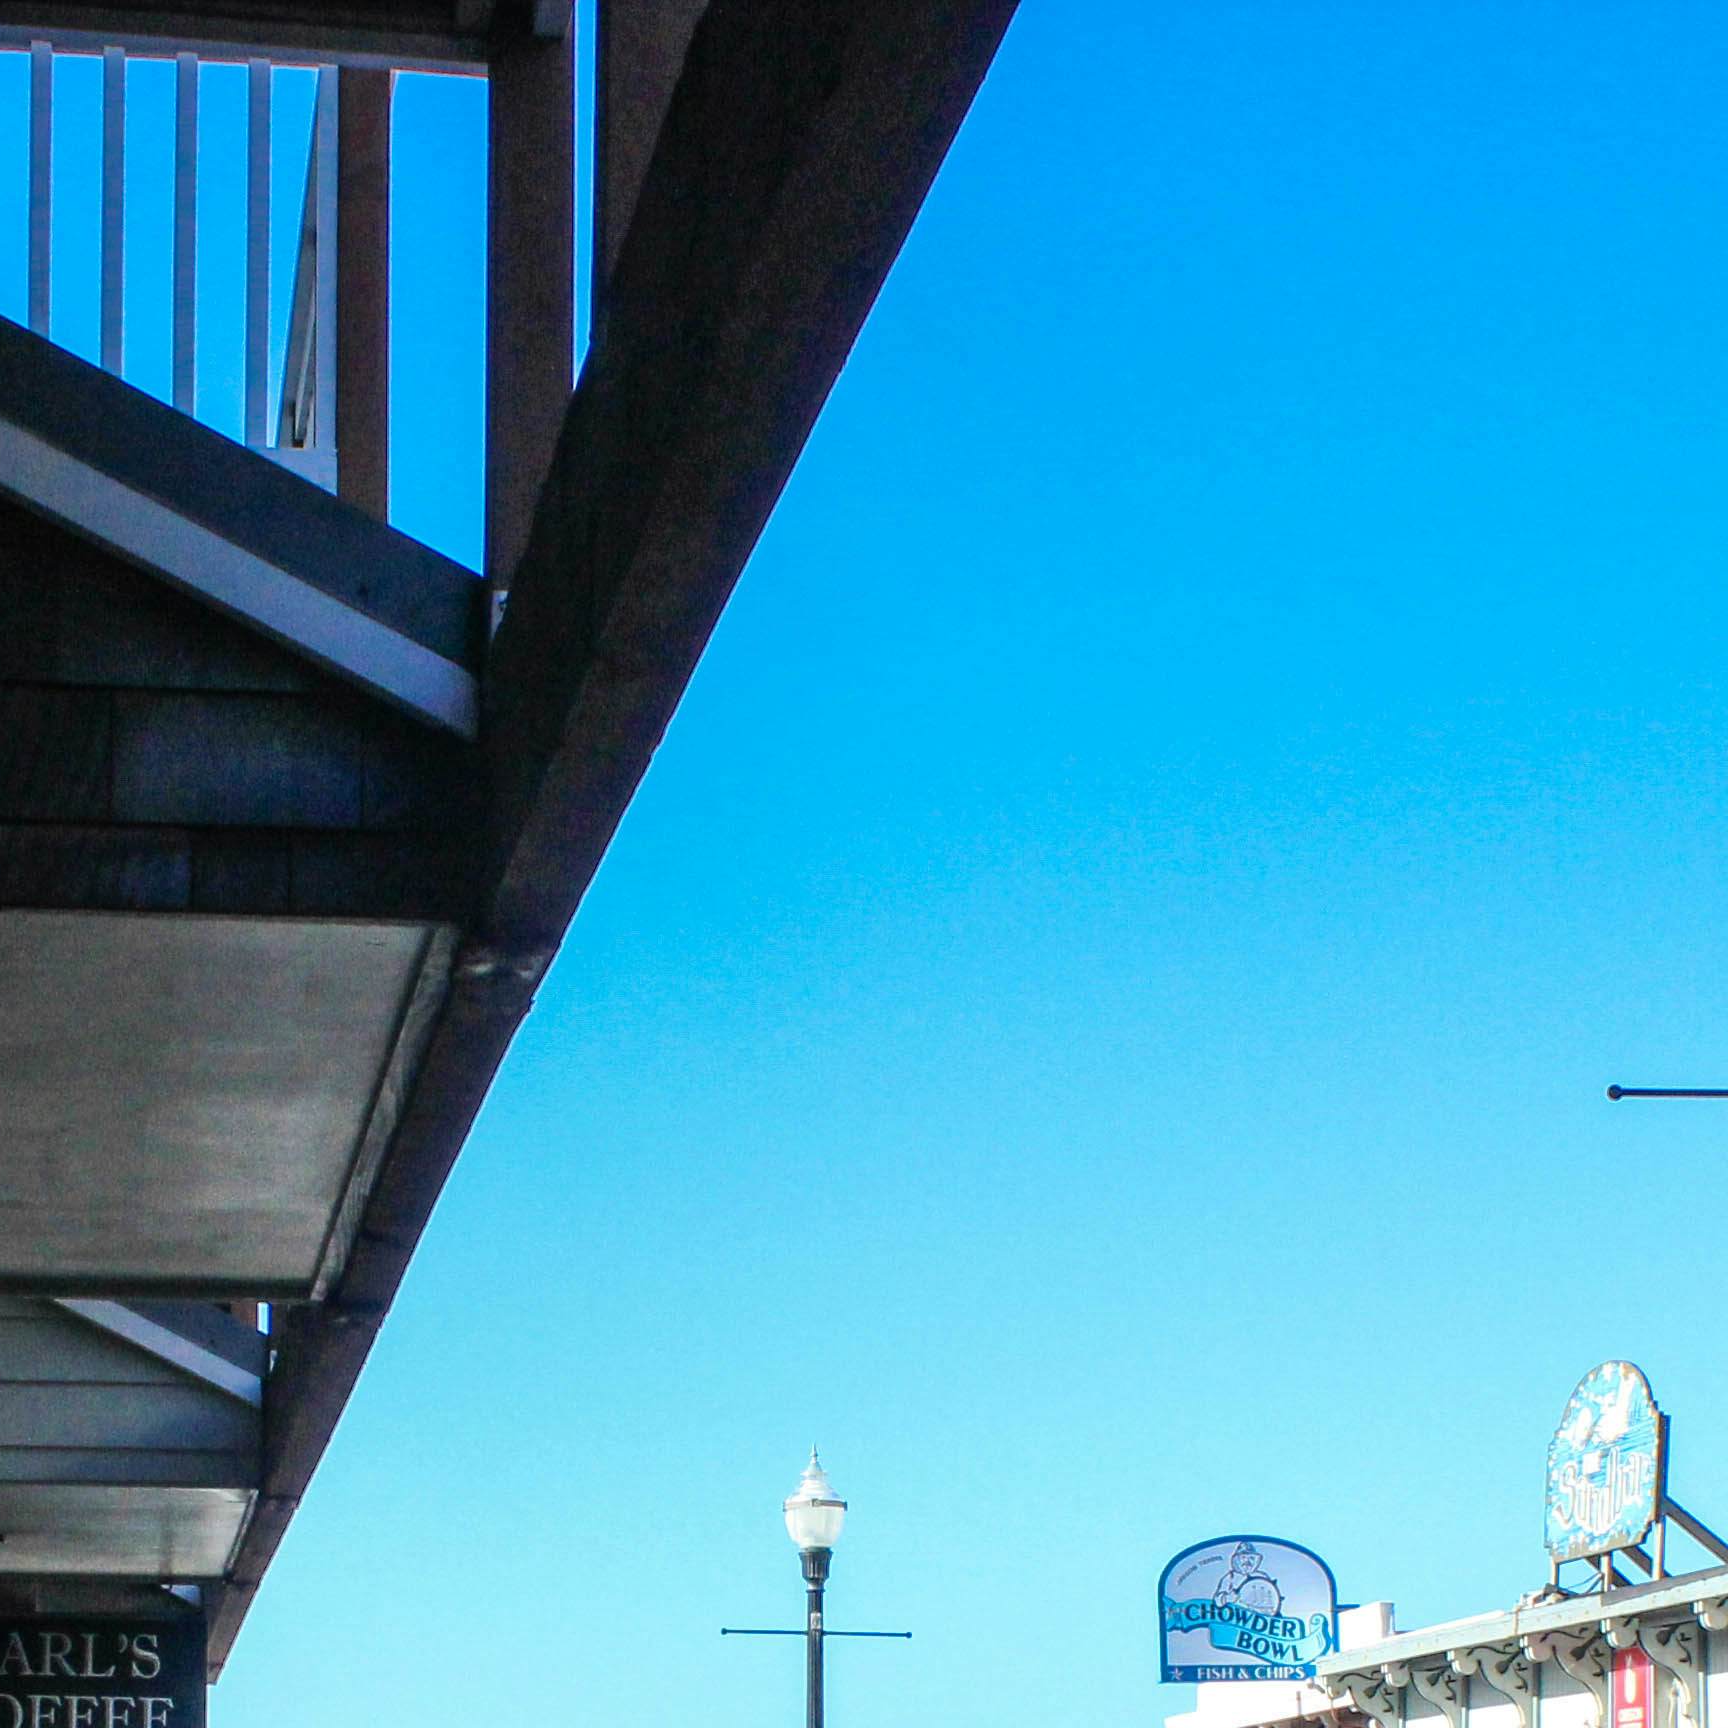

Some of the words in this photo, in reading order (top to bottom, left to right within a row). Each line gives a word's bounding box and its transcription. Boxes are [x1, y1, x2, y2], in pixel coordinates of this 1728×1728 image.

[1185, 1602, 1297, 1639] CHOWDER
[1237, 1631, 1305, 1662] BOWL
[1197, 1667, 1233, 1680] FISH
[1237, 1667, 1249, 1680] &
[1254, 1666, 1306, 1680] CHIPS
